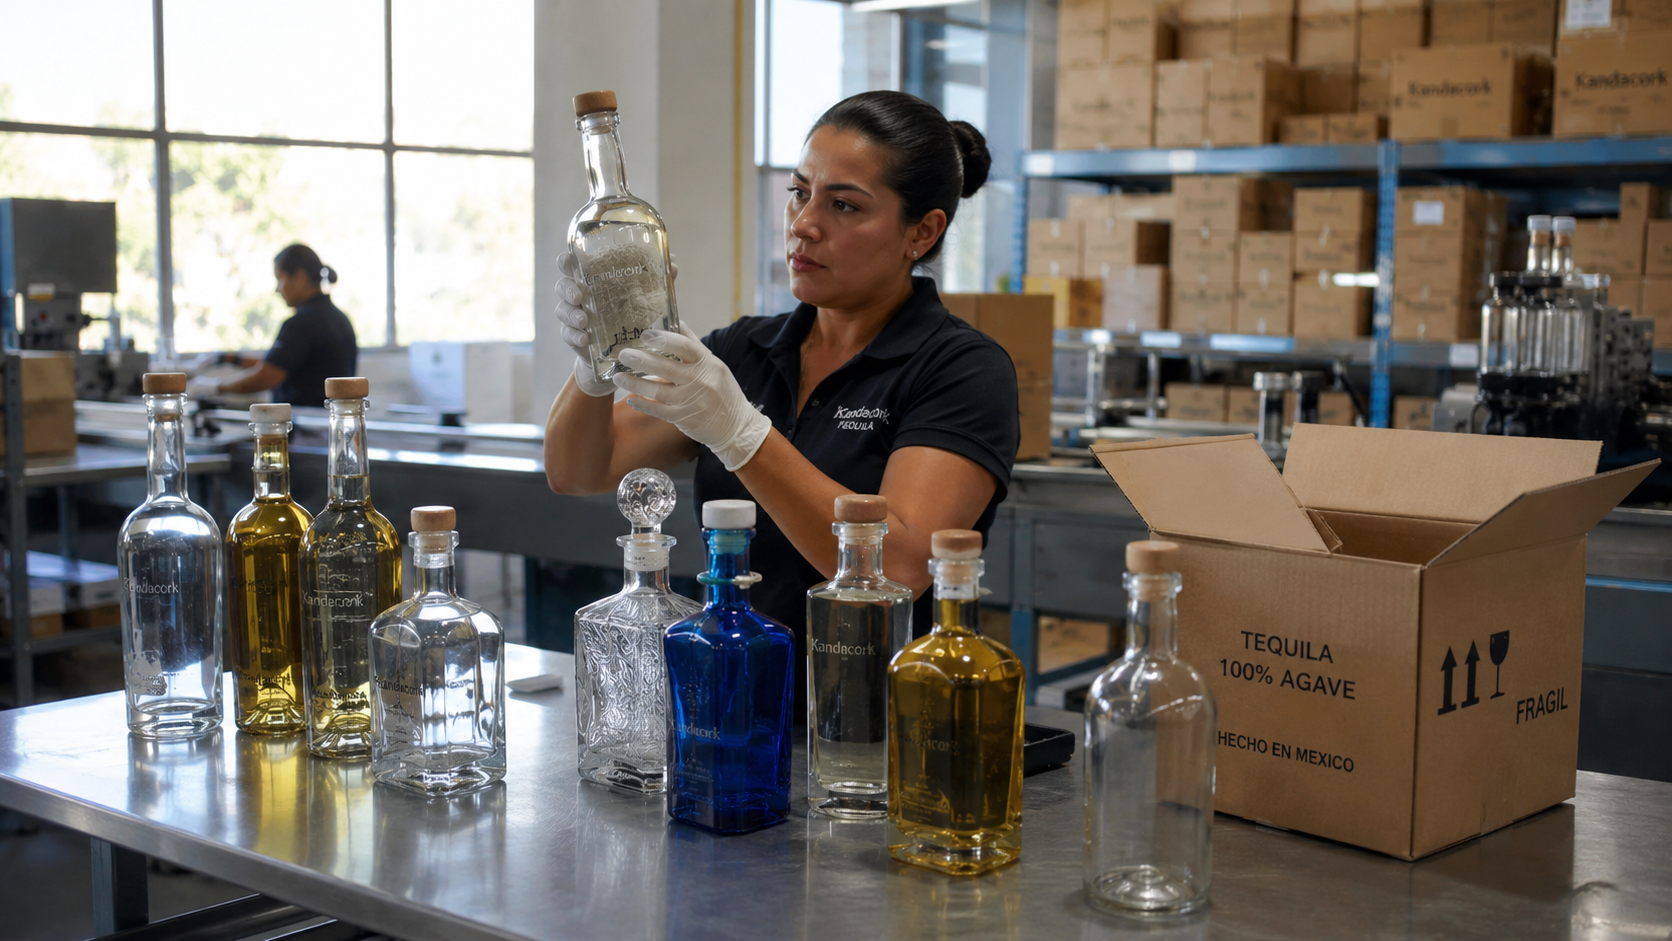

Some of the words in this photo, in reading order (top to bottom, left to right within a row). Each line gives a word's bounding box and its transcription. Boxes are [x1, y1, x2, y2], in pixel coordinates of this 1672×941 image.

[1408, 79, 1492, 97] Kandacork
[1576, 69, 1668, 90] Kandacork
[811, 638, 876, 655] Kandacork
[1241, 630, 1334, 664] TEQUILA
[1220, 658, 1273, 685] 100%
[1280, 669, 1356, 700] AGAVE
[1516, 687, 1568, 725] FRAGIL
[1218, 731, 1268, 754] HECHO
[1272, 742, 1291, 759] EN
[1296, 747, 1355, 773] MEXICO
